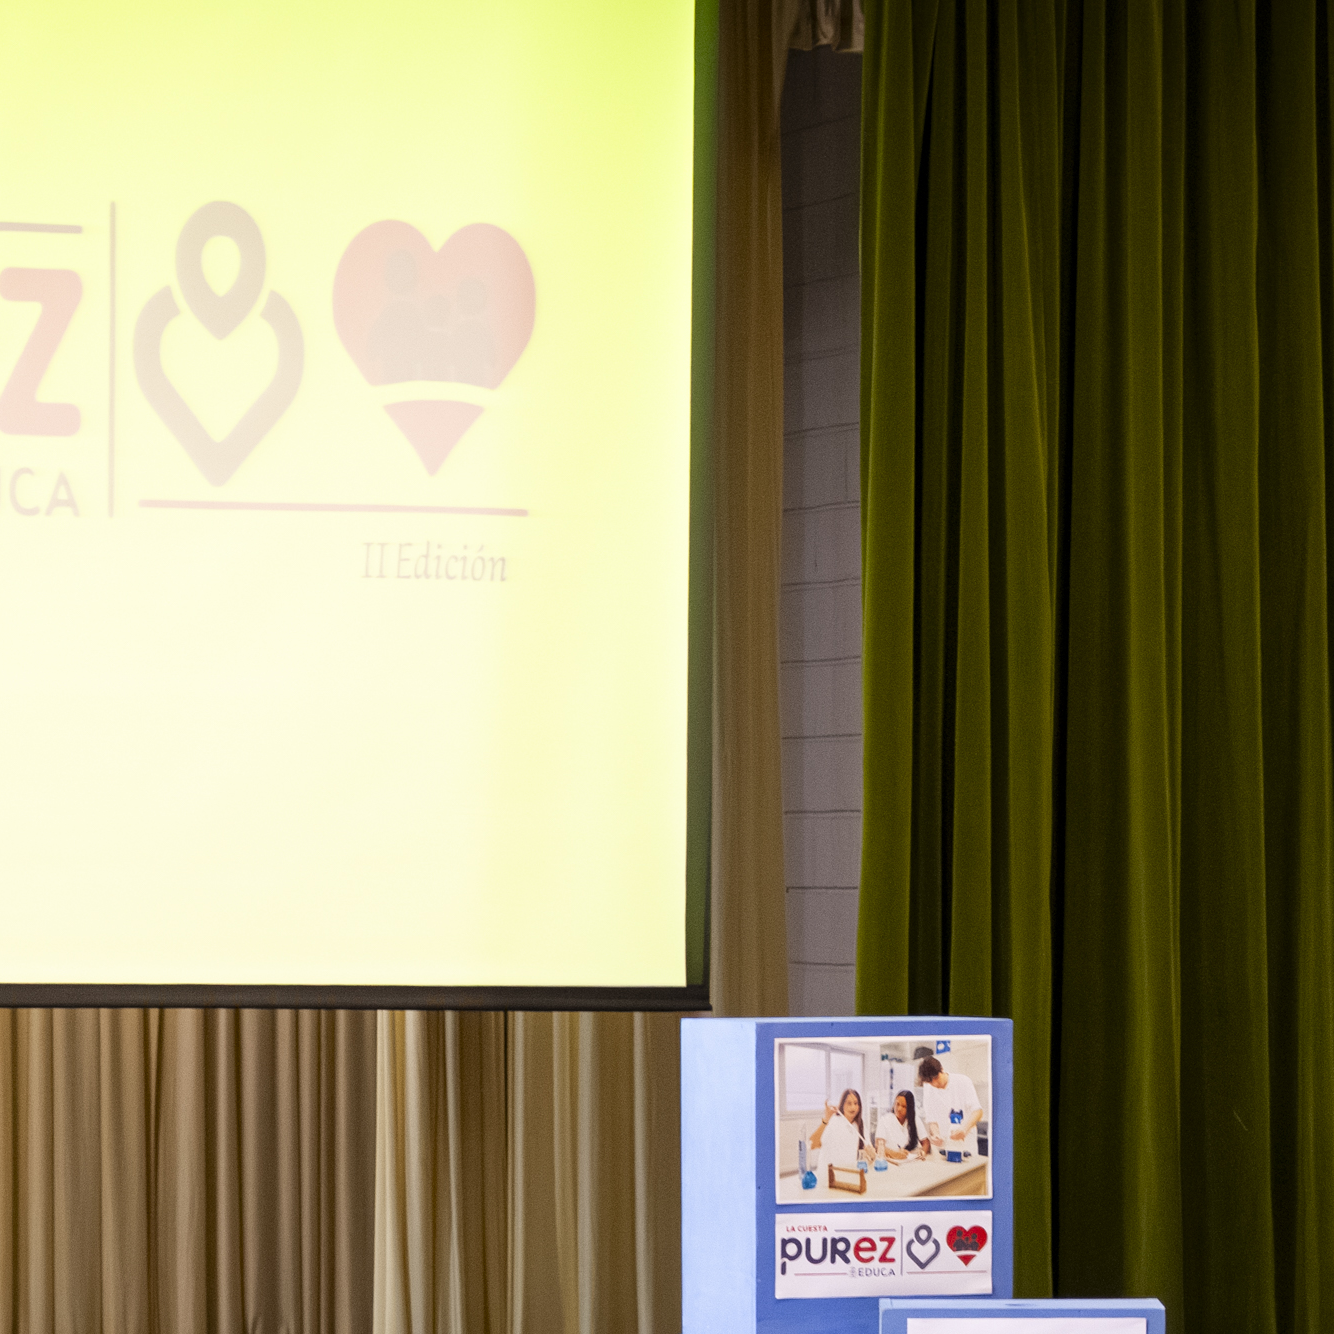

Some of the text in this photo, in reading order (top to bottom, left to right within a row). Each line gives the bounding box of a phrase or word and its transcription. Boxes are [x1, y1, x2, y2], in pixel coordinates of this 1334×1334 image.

[361, 540, 508, 583] II Edición
[785, 1225, 829, 1233] LA CUESTA
[857, 1267, 897, 1277] EDUCA
